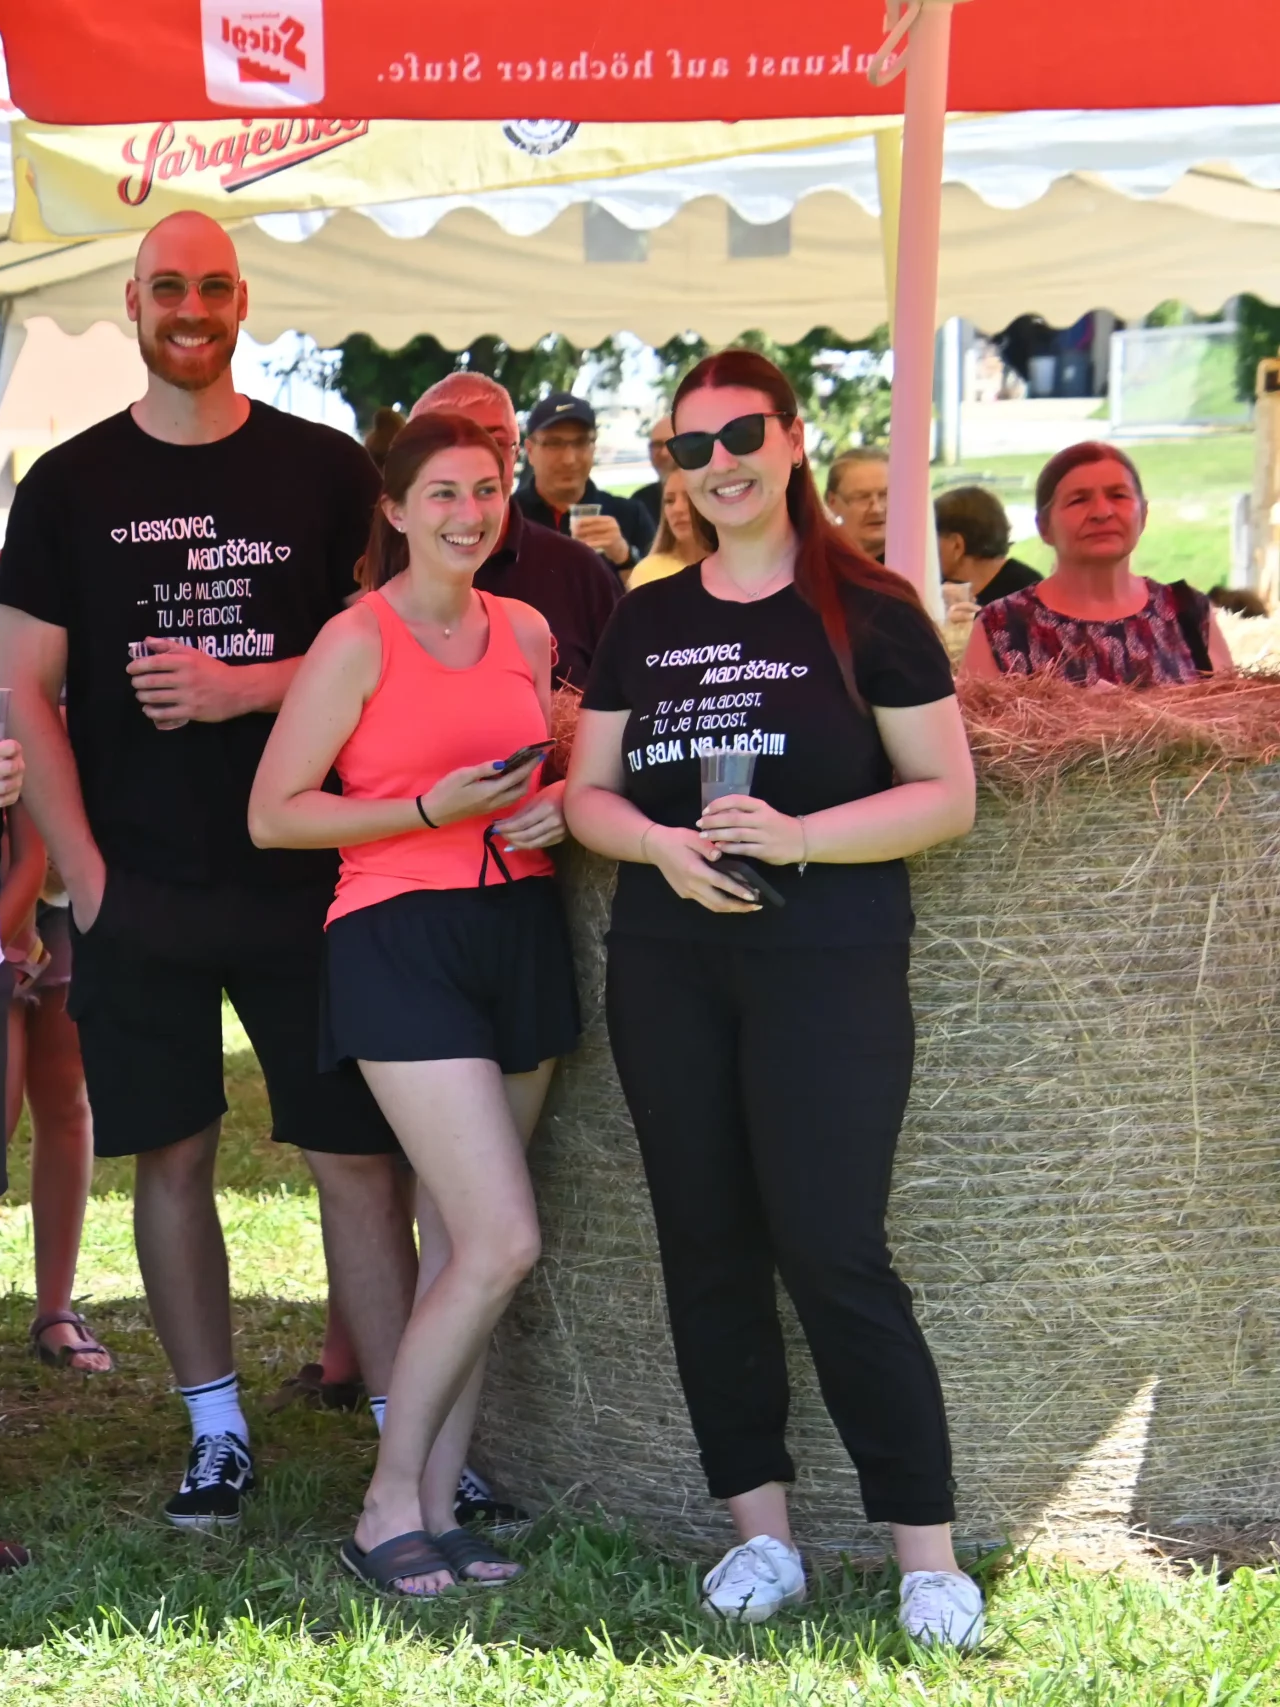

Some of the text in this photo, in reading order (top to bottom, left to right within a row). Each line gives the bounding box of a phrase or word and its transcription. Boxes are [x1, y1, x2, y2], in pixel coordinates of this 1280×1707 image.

[153, 583, 170, 602] TU
[157, 609, 172, 628] TU
[655, 701, 672, 716] TU
[652, 719, 668, 736] TU
[628, 749, 641, 773] TU
